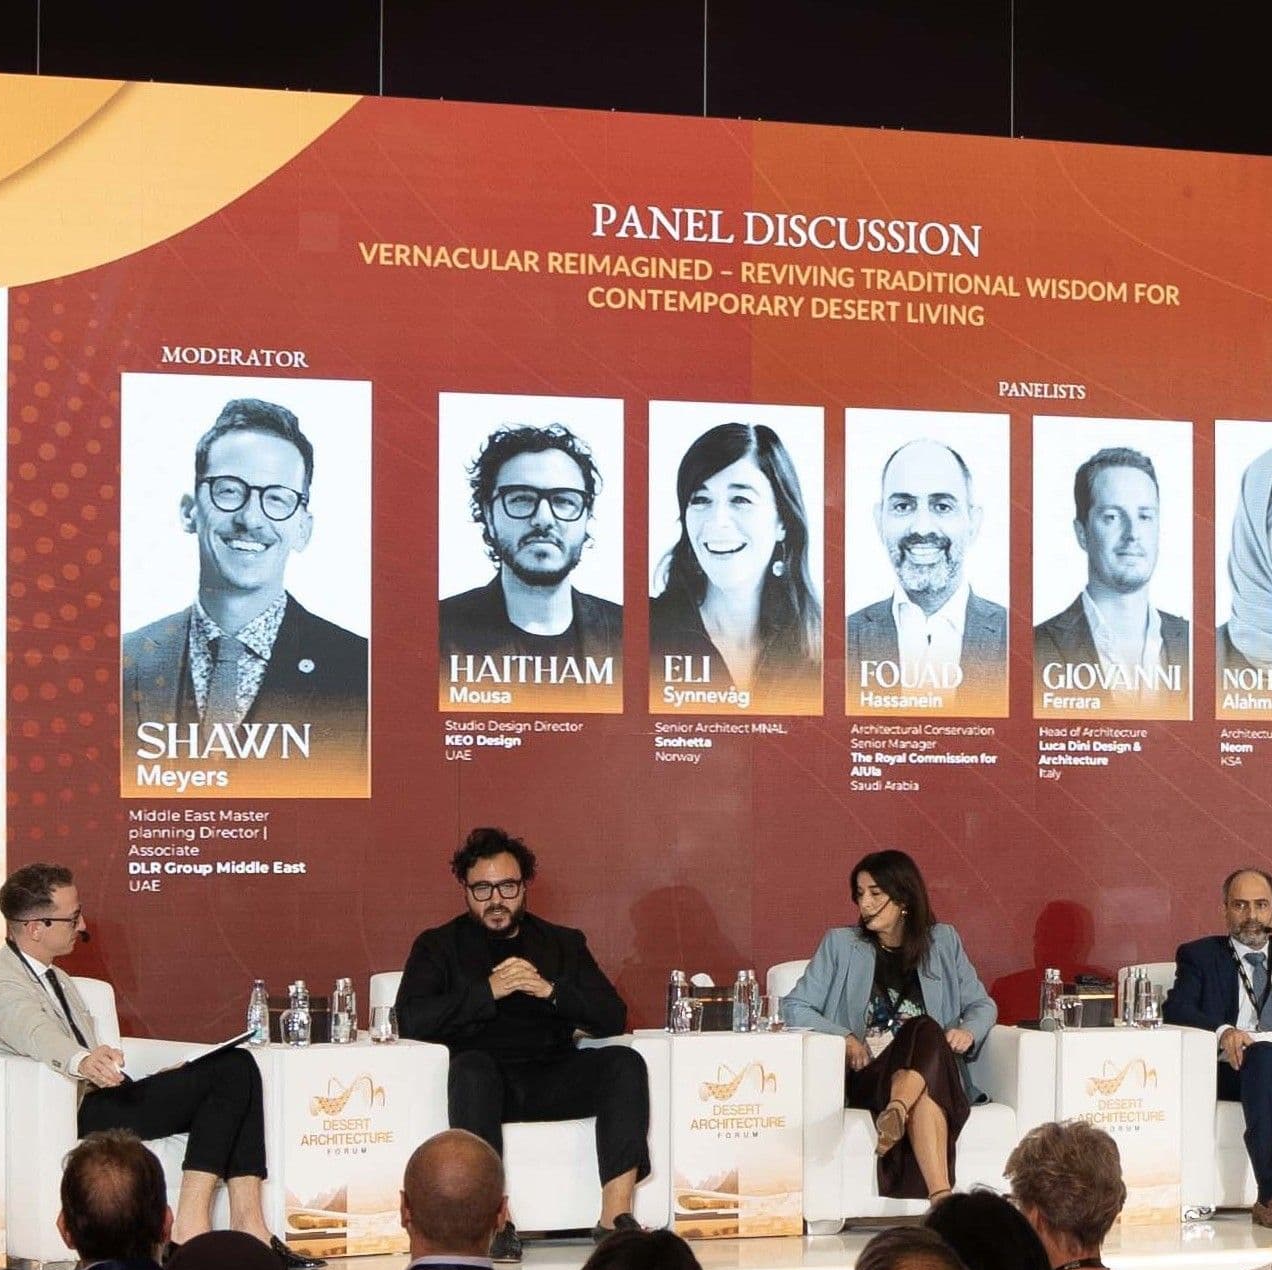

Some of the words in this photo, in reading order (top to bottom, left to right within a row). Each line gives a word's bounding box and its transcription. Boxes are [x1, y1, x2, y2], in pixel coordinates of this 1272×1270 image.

[591, 203, 734, 244] PANEL
[743, 211, 982, 257] DISCUSSION
[358, 241, 540, 274] VERNACULAR
[547, 251, 713, 282] REIMAGINED
[740, 261, 855, 289] REVIVING
[860, 267, 1020, 298] TRADITIONAL
[1026, 277, 1127, 303] WISDOM
[1134, 282, 1180, 306] FOR
[587, 286, 804, 318] CONTEMPORARY
[811, 296, 900, 322] DESERT
[906, 302, 985, 326] LIVING
[161, 346, 309, 368] MODERATOR
[998, 381, 1086, 400] PANELISTS
[450, 654, 614, 685] HAITHAM
[663, 655, 711, 683] ELI
[860, 660, 964, 689] FOUAD
[1042, 662, 1182, 691] GIOVANNI
[449, 686, 512, 704] Mousa
[663, 685, 751, 708] Synnevåg
[860, 691, 944, 708] Hassanein
[1042, 692, 1101, 709] Ferrara
[445, 719, 485, 731] Studio
[488, 720, 531, 734] Design
[534, 720, 584, 732] Director
[654, 722, 693, 733] Senior
[695, 722, 750, 734] Architect
[850, 724, 922, 735] Architectural
[924, 724, 995, 736] Conservation
[1039, 726, 1067, 737] Head
[1070, 726, 1081, 737] of
[1082, 727, 1148, 738] Architecture
[136, 721, 312, 760] SHAWN
[445, 734, 474, 746] KEO
[477, 734, 522, 748] Design
[850, 738, 887, 749] Senior
[888, 739, 937, 751] Manager
[1039, 740, 1066, 751] Luca
[1068, 740, 1091, 751] Dini
[1092, 741, 1132, 754] Design
[1133, 741, 1141, 751] &
[1220, 742, 1253, 753] Neom
[445, 749, 472, 761] UAE
[655, 751, 701, 764] Norway
[850, 752, 873, 763] The
[875, 752, 907, 766] Royal
[908, 752, 978, 764] Commission
[980, 752, 998, 764] for
[1038, 754, 1109, 766] Architecture
[1220, 756, 1242, 766] KSA
[136, 764, 229, 793] Meyers
[1039, 768, 1062, 780] Italy
[850, 780, 882, 791] Saudi
[884, 780, 920, 791] Arabia
[128, 809, 181, 822] Middle
[184, 809, 216, 822] East
[219, 809, 270, 822] Master
[128, 826, 196, 840] planning
[199, 826, 260, 839] Director
[128, 844, 200, 857] Associate
[128, 862, 162, 875] DLR
[164, 862, 214, 876] Group
[216, 861, 270, 874] Middle
[272, 861, 307, 874] East
[128, 879, 161, 892] UAE
[712, 1103, 761, 1116] DESERT
[1097, 1098, 1144, 1110] DESERT
[322, 1118, 372, 1131] DESERT
[690, 1116, 786, 1130] ARCHITECTURE
[300, 1131, 395, 1146] ARCHITECTURE
[717, 1131, 759, 1139] FORUM
[326, 1147, 367, 1155] FORUM
